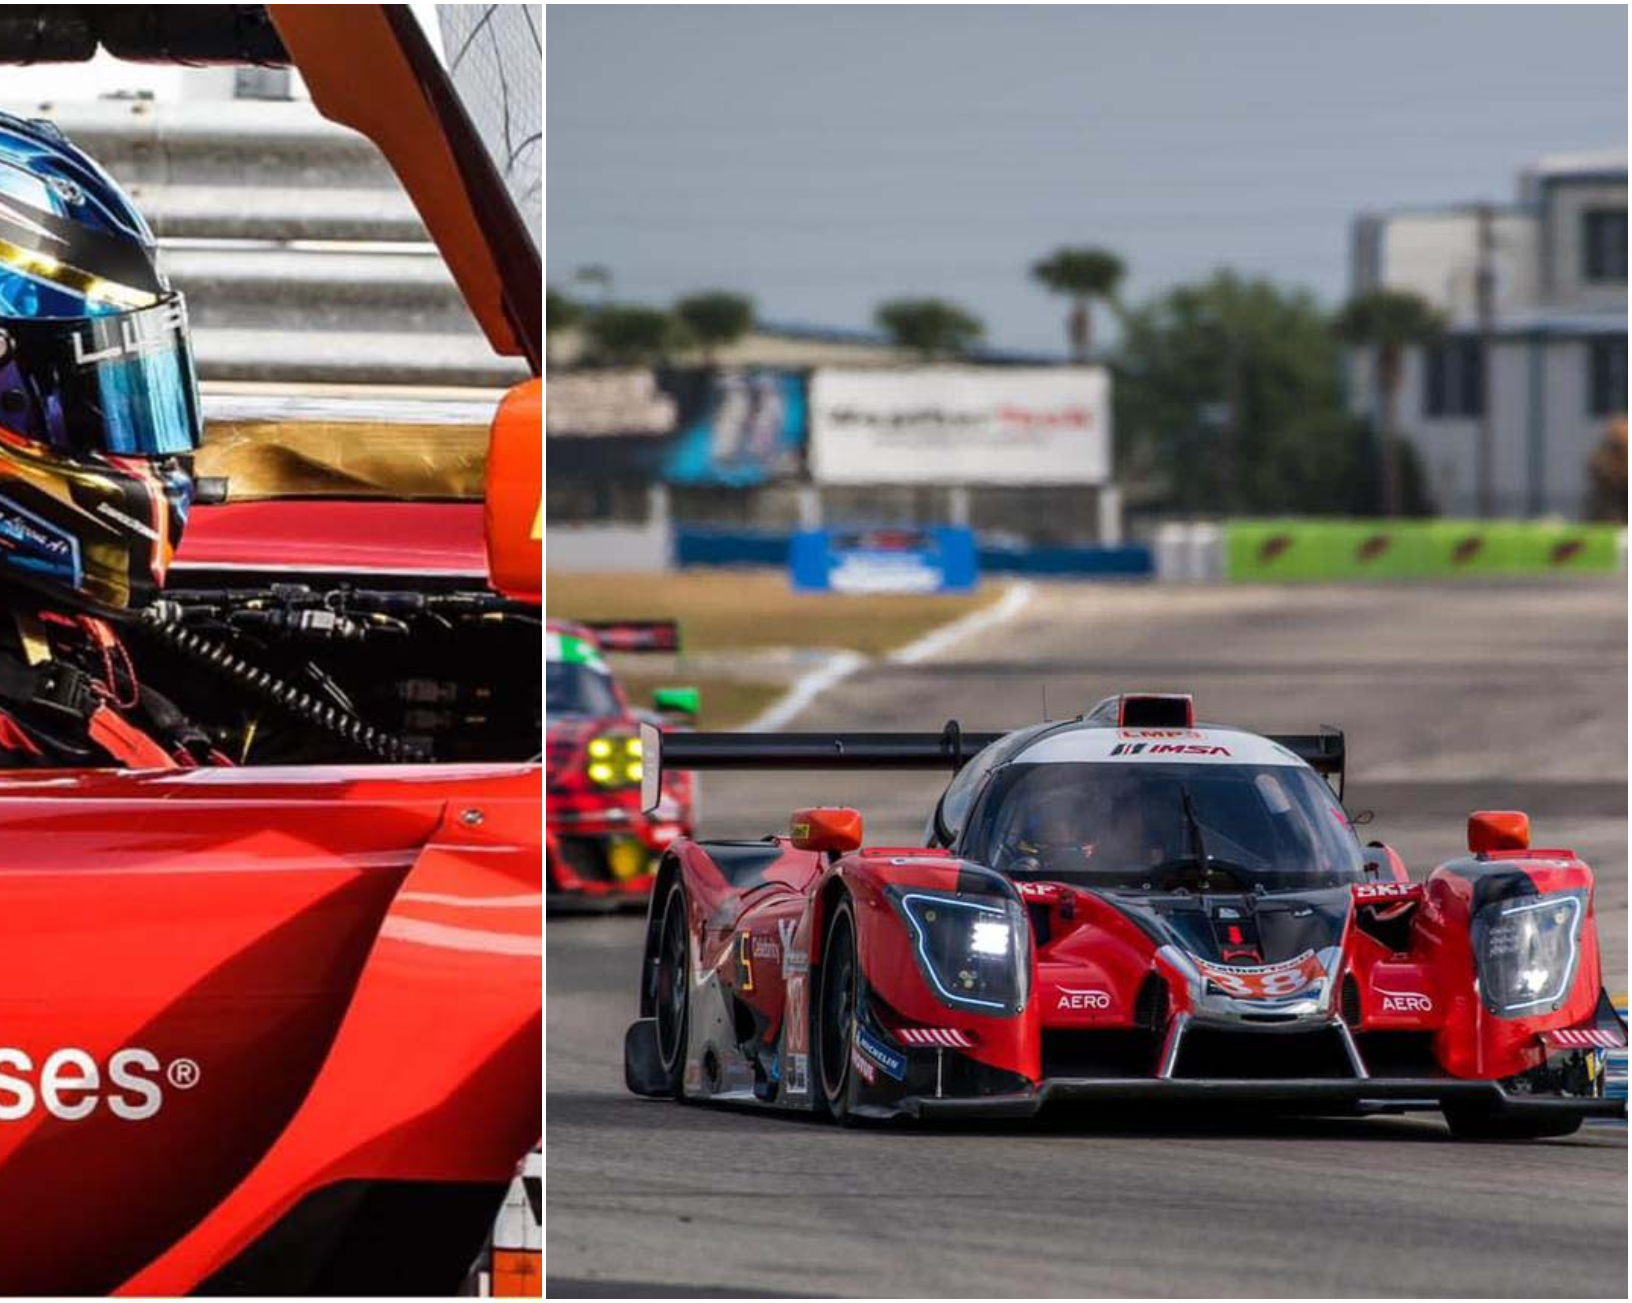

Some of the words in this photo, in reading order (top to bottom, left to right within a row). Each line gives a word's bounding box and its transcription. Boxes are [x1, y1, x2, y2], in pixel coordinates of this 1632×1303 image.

[1149, 744, 1231, 757] IMSA
[1357, 885, 1417, 898] SKF
[1210, 971, 1303, 996] 38
[1057, 994, 1112, 1010] AERO
[1383, 996, 1432, 1012] AERO
